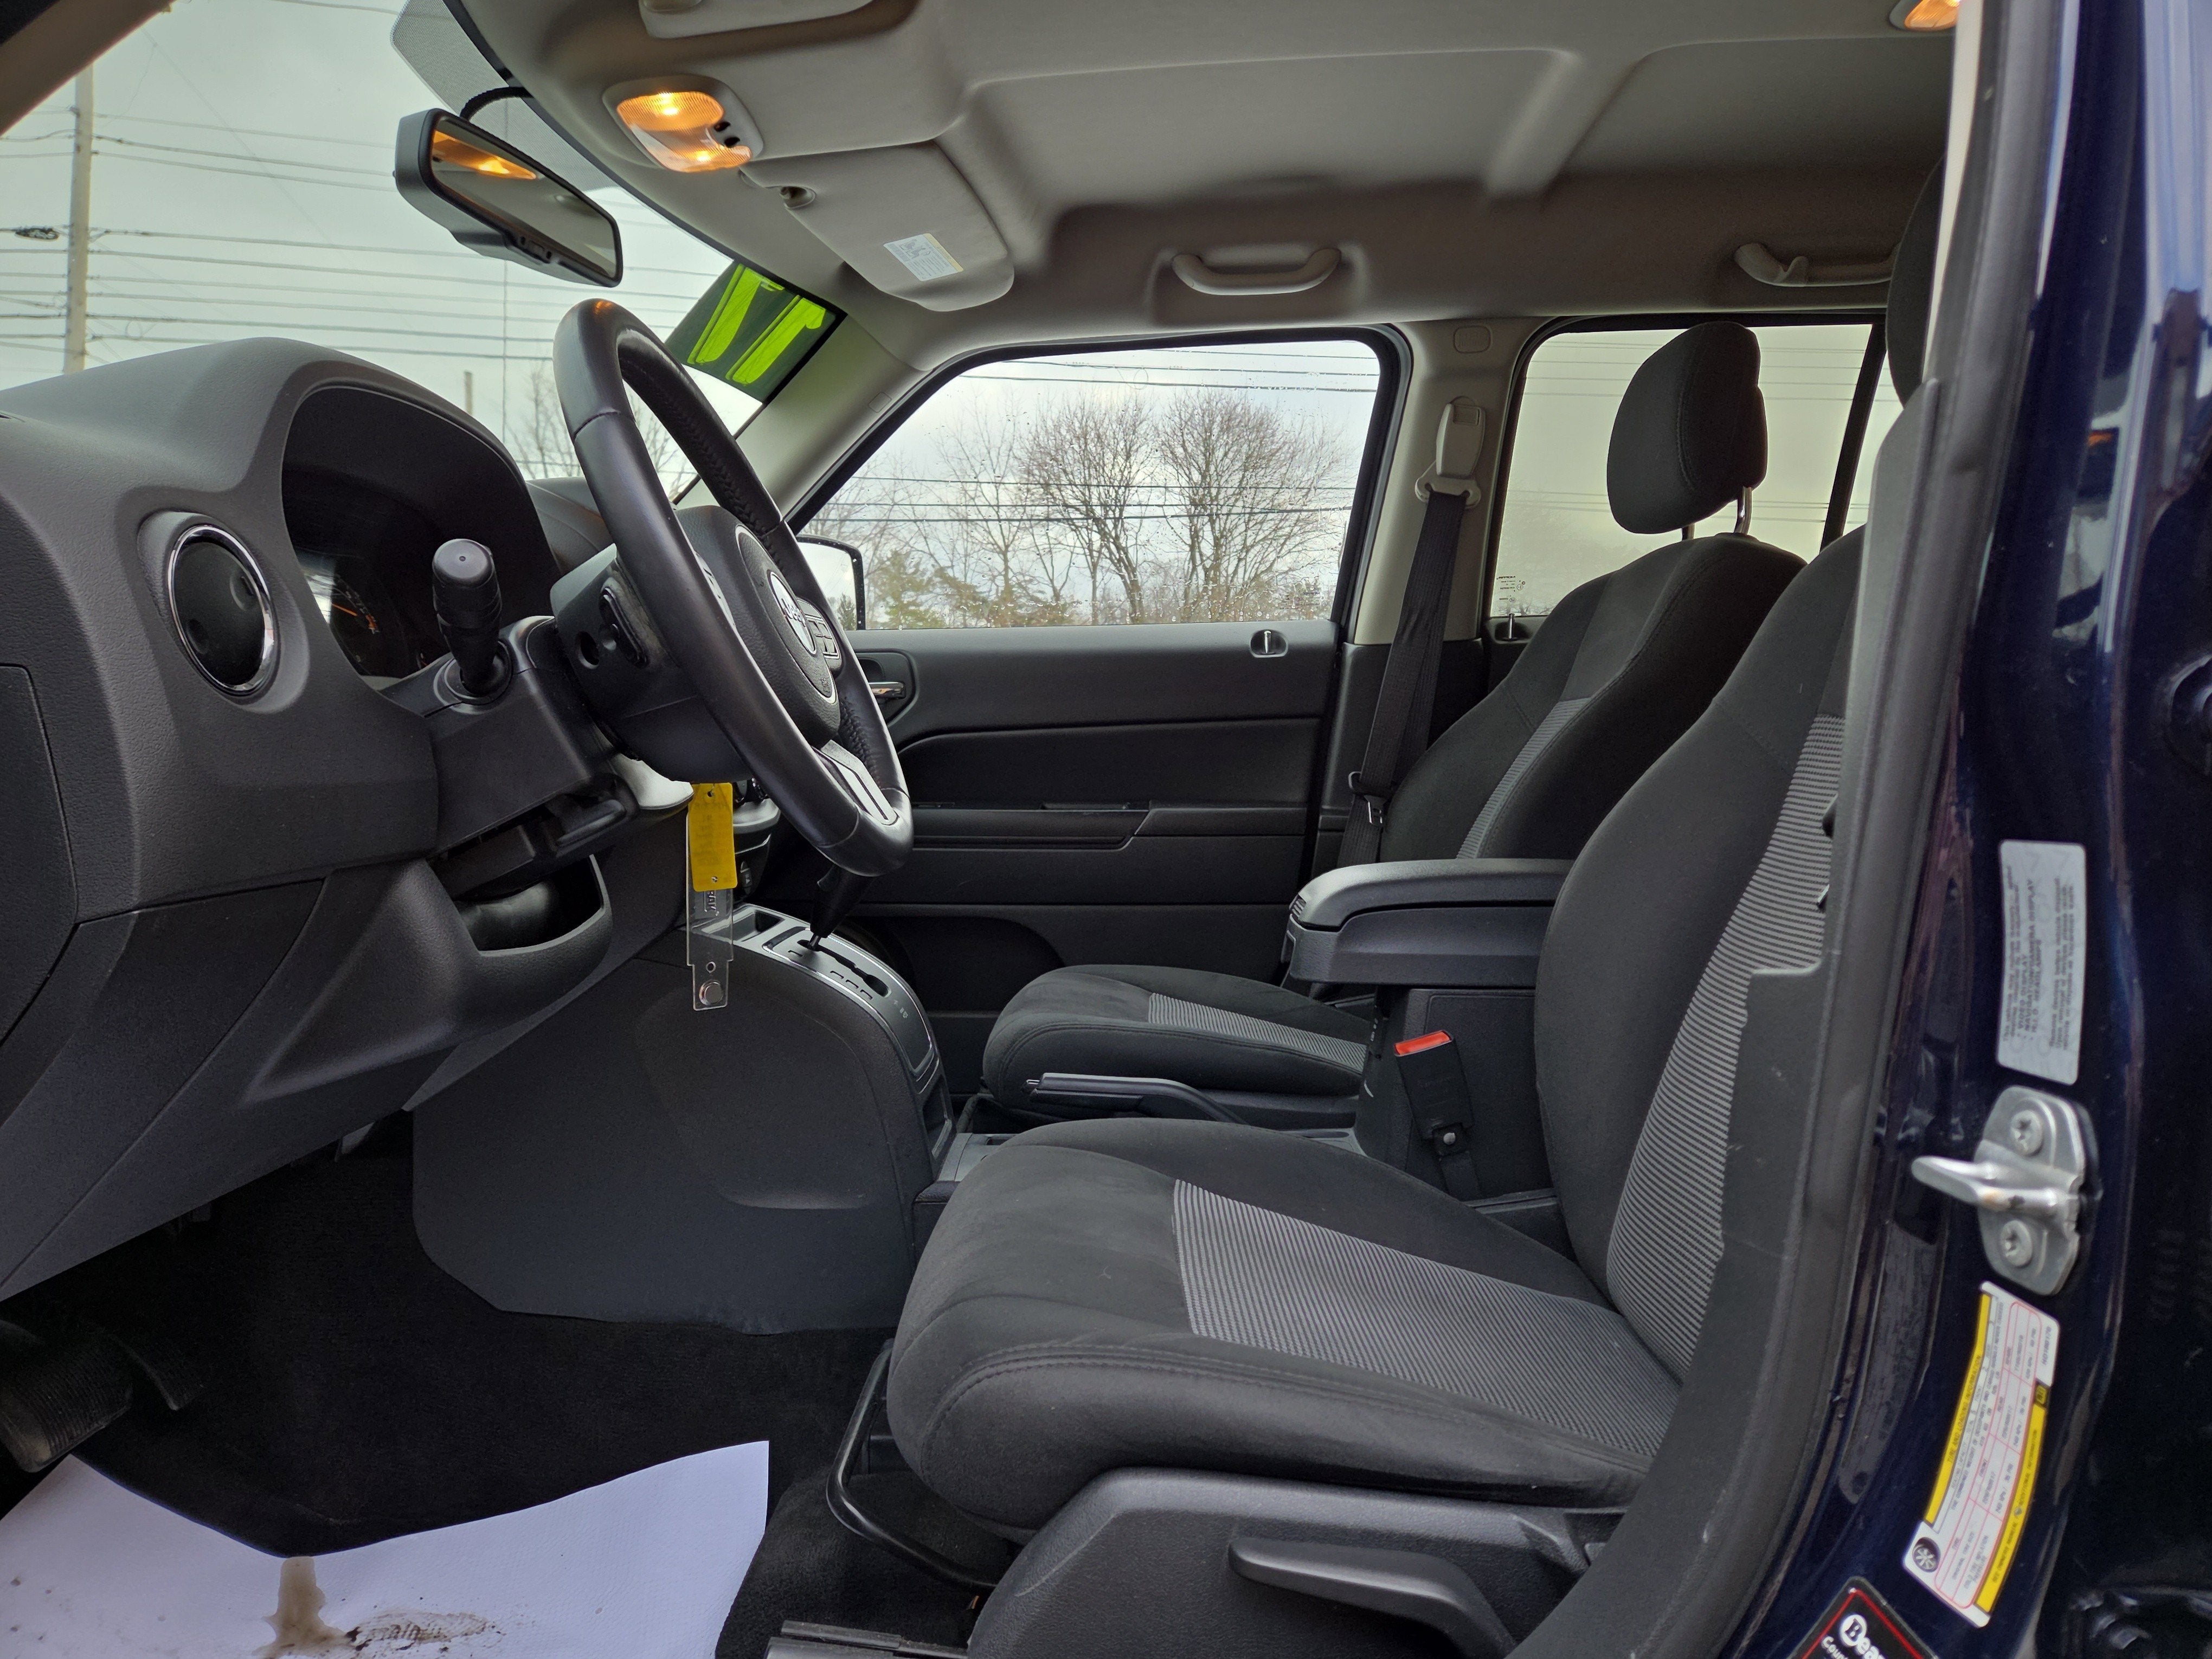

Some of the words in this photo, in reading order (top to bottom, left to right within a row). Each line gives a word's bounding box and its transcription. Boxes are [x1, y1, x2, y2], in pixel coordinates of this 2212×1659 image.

[781, 598, 806, 627] Jeep
[1822, 1636, 1848, 1659] Coun
[1843, 1616, 1885, 1659] Bea
